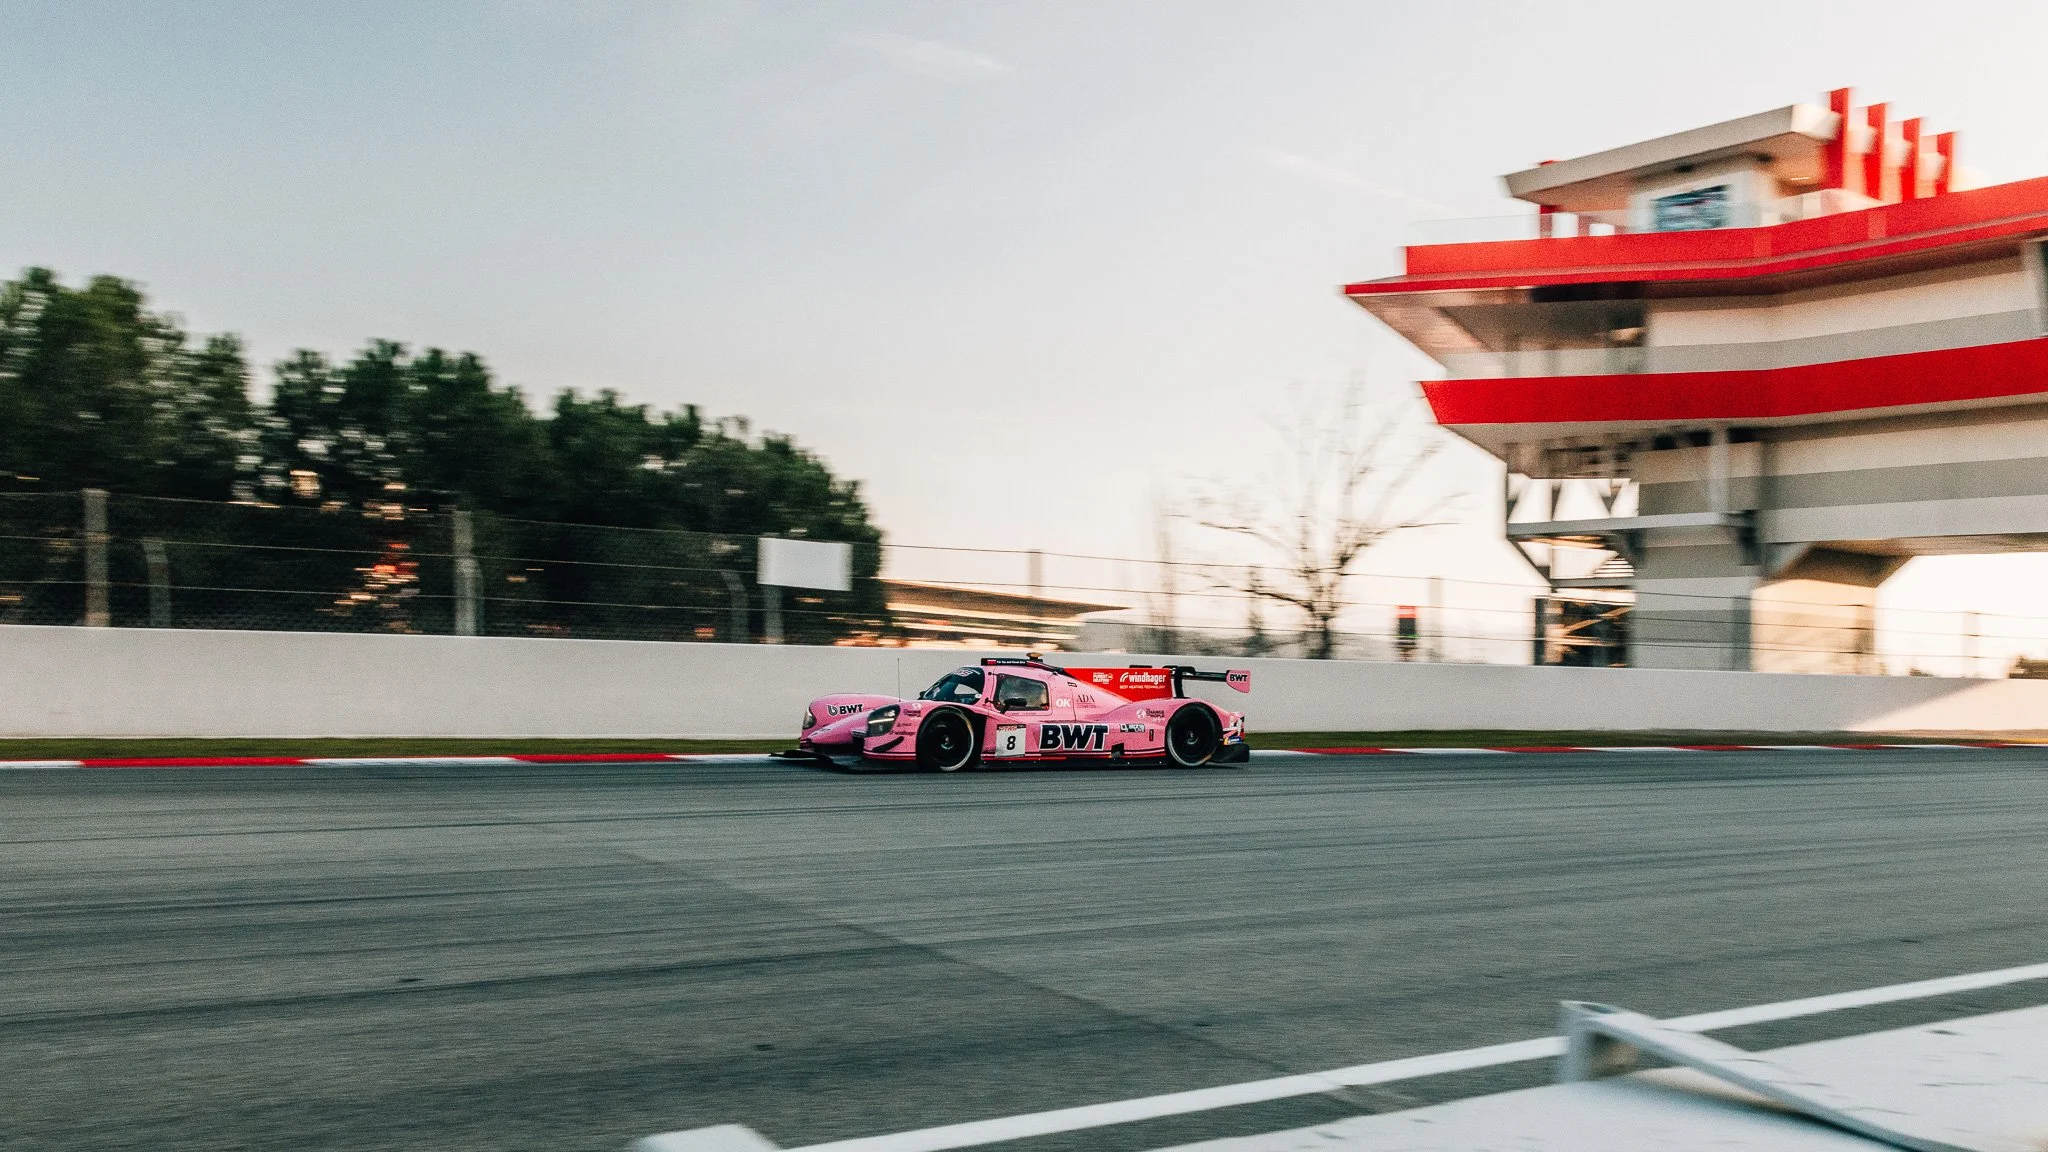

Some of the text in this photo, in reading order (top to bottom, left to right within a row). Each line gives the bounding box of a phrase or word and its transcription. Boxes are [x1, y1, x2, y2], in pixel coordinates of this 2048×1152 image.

[1129, 672, 1166, 685] windhager
[1230, 674, 1247, 682] BWT
[1056, 698, 1071, 708] OK
[1077, 694, 1095, 702] ADA
[840, 704, 863, 715] BWT
[1039, 724, 1109, 750] BWT
[1006, 735, 1016, 751] 8
